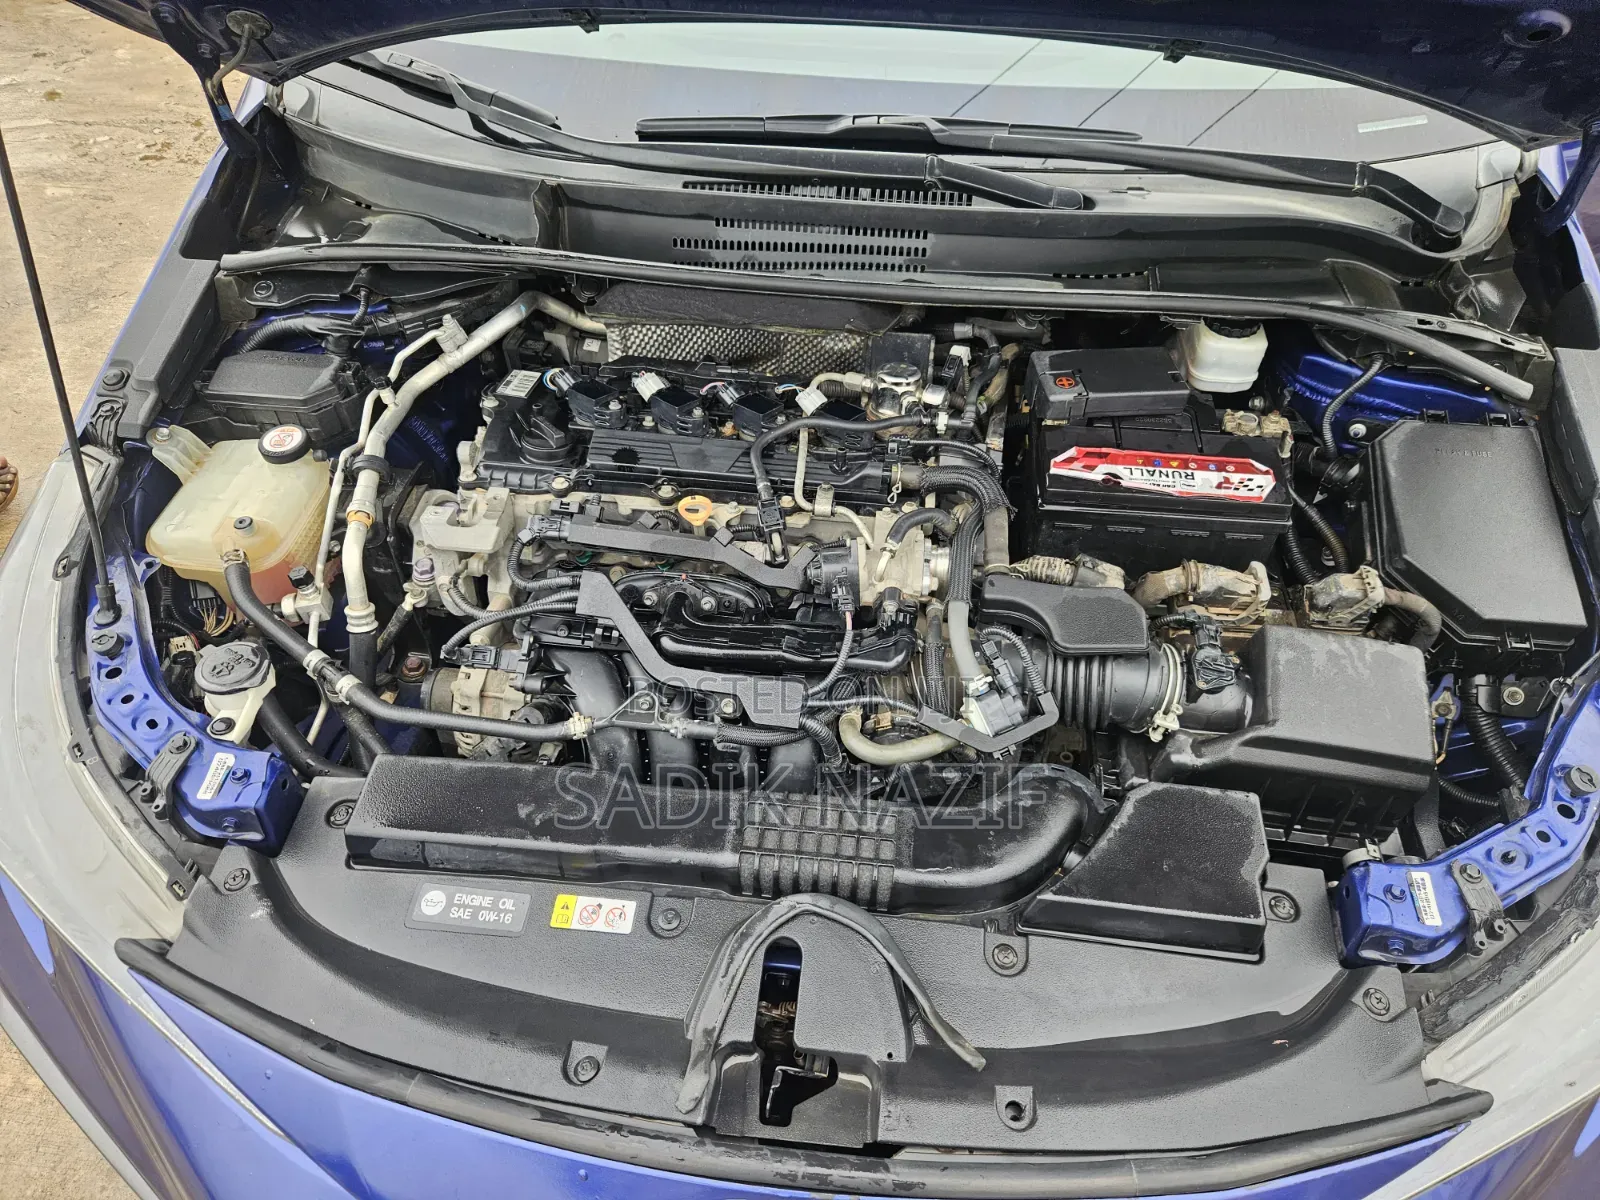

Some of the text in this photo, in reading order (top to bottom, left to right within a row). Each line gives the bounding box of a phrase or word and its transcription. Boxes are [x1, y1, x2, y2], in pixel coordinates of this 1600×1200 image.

[1123, 466, 1195, 481] RUNALL
[453, 893, 516, 911] ENGINE OIL
[449, 907, 513, 924] SAE 0W-16
